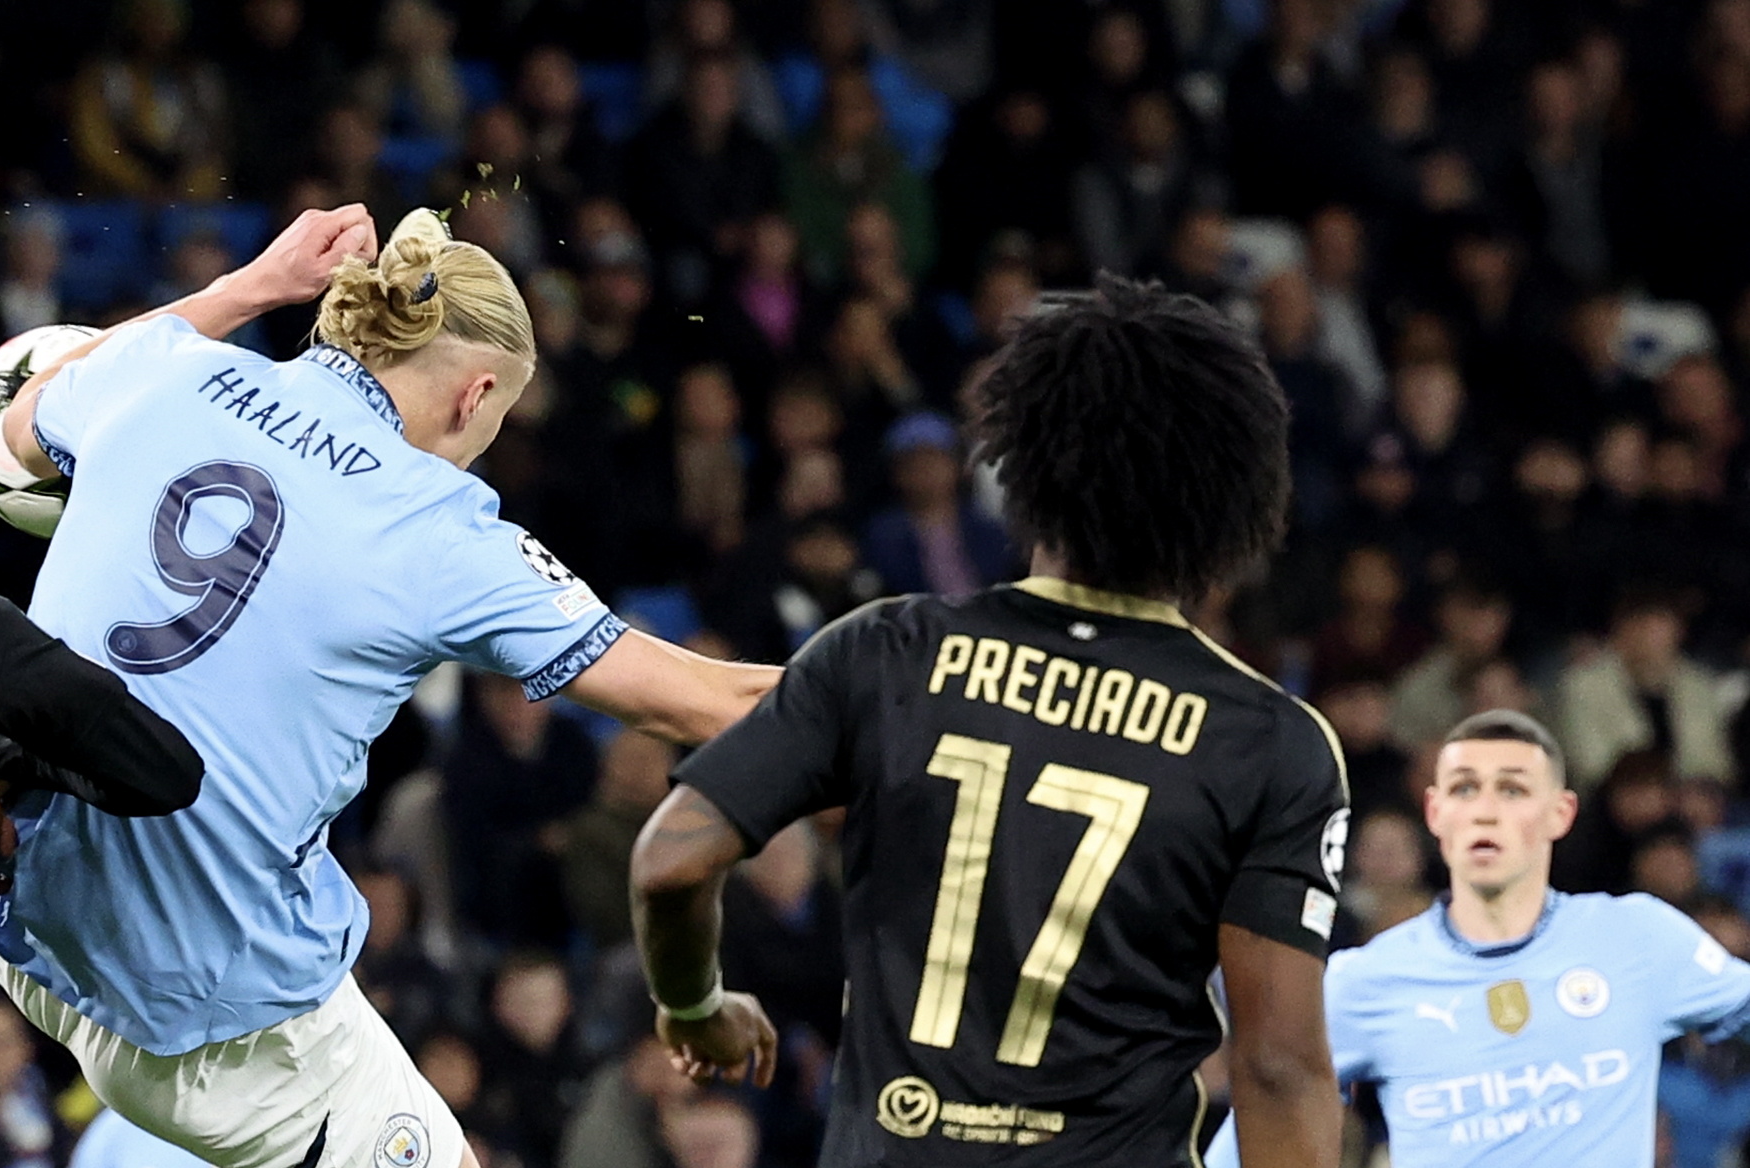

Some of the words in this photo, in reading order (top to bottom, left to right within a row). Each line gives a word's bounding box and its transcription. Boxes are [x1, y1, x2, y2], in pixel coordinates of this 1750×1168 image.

[198, 367, 381, 477] HAALAND
[104, 459, 285, 675] 9
[928, 634, 1208, 756] PRECIADO
[909, 733, 1150, 1068] 17
[1404, 1049, 1630, 1119] ETIHAD
[1450, 1101, 1583, 1146] AIRWAYS
